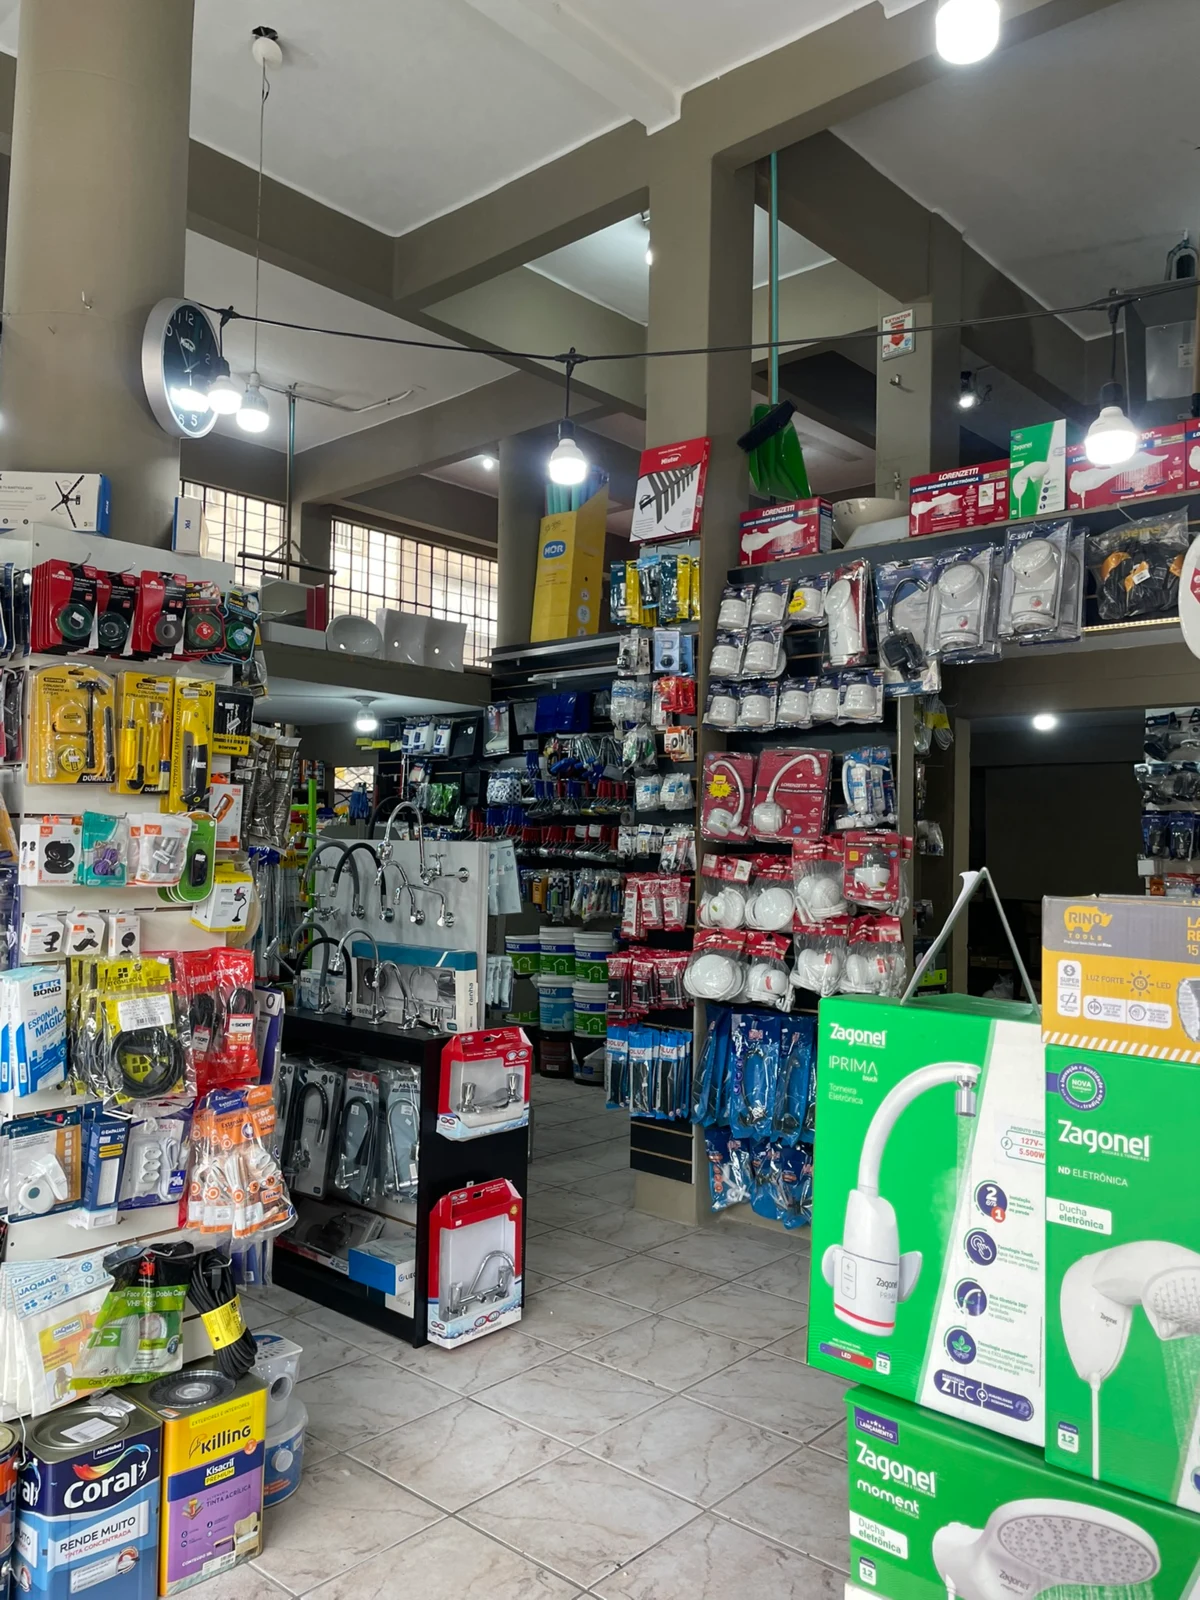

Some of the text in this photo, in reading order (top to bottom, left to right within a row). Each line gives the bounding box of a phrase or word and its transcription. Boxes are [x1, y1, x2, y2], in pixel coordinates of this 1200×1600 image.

[938, 467, 979, 481] LORENZETTI
[762, 504, 796, 516] LORENZETTI
[1068, 912, 1102, 924] RINO
[1068, 932, 1102, 941] TOOLS
[1186, 944, 1198, 956] 15
[1102, 976, 1124, 985] FORTE
[34, 986, 62, 997] BOND
[28, 1006, 59, 1030] ESPONJA
[830, 1022, 886, 1046] Zagonel
[829, 1083, 857, 1095] Torneira
[1072, 1078, 1092, 1088] NOVA
[1058, 1119, 1151, 1158] Zagonel
[1058, 1165, 1128, 1188] ND ELETRÔNICA
[986, 1186, 998, 1202] 2
[1058, 1202, 1088, 1218] Ducha
[1058, 1214, 1104, 1231] eletrônica
[19, 1274, 58, 1296] JAQMAR
[156, 1290, 173, 1298] Doble
[841, 1352, 852, 1360] LED
[878, 1360, 888, 1369] 12
[859, 1420, 894, 1440] LANÇAMENTO
[1061, 1433, 1075, 1445] 12
[206, 1457, 236, 1476] Kisacril
[856, 1440, 936, 1494] Zagonel
[206, 1468, 234, 1484] PREMIUM
[64, 1463, 137, 1509] Coral
[206, 1484, 252, 1508] TINTA ACRÍLICA
[857, 1479, 920, 1514] moment
[60, 1516, 136, 1554] RENDE MUITO
[858, 1517, 886, 1538] Ducha
[64, 1530, 132, 1559] TINTA CONCENTRADA
[858, 1530, 902, 1554] eletrônica
[862, 1568, 873, 1578] 12
